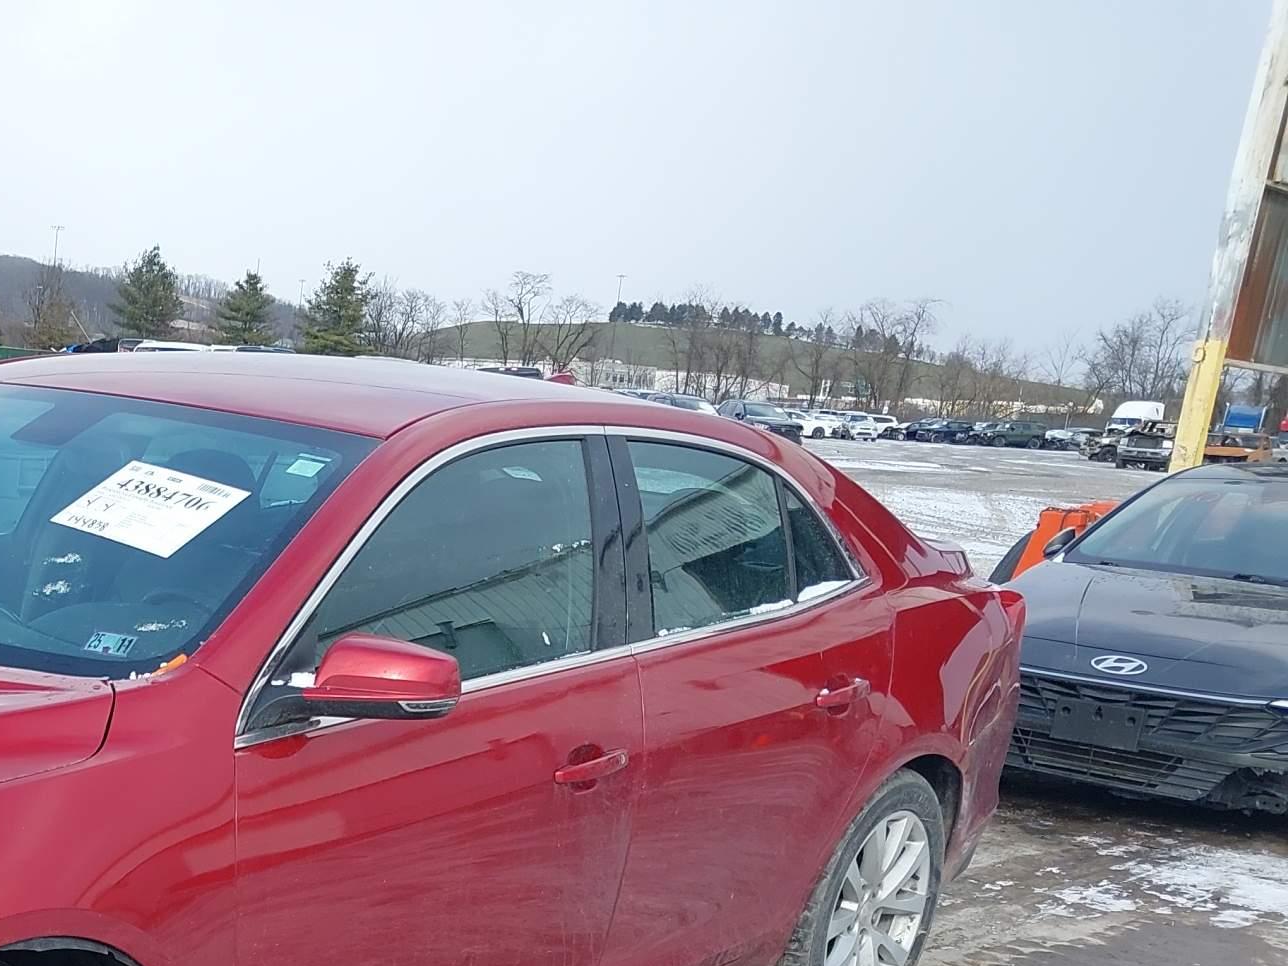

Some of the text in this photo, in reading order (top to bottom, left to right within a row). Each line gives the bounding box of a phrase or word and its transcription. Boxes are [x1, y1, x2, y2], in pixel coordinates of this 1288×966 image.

[117, 478, 216, 511] 43884706
[88, 633, 106, 649] 25
[116, 637, 134, 654] 11
